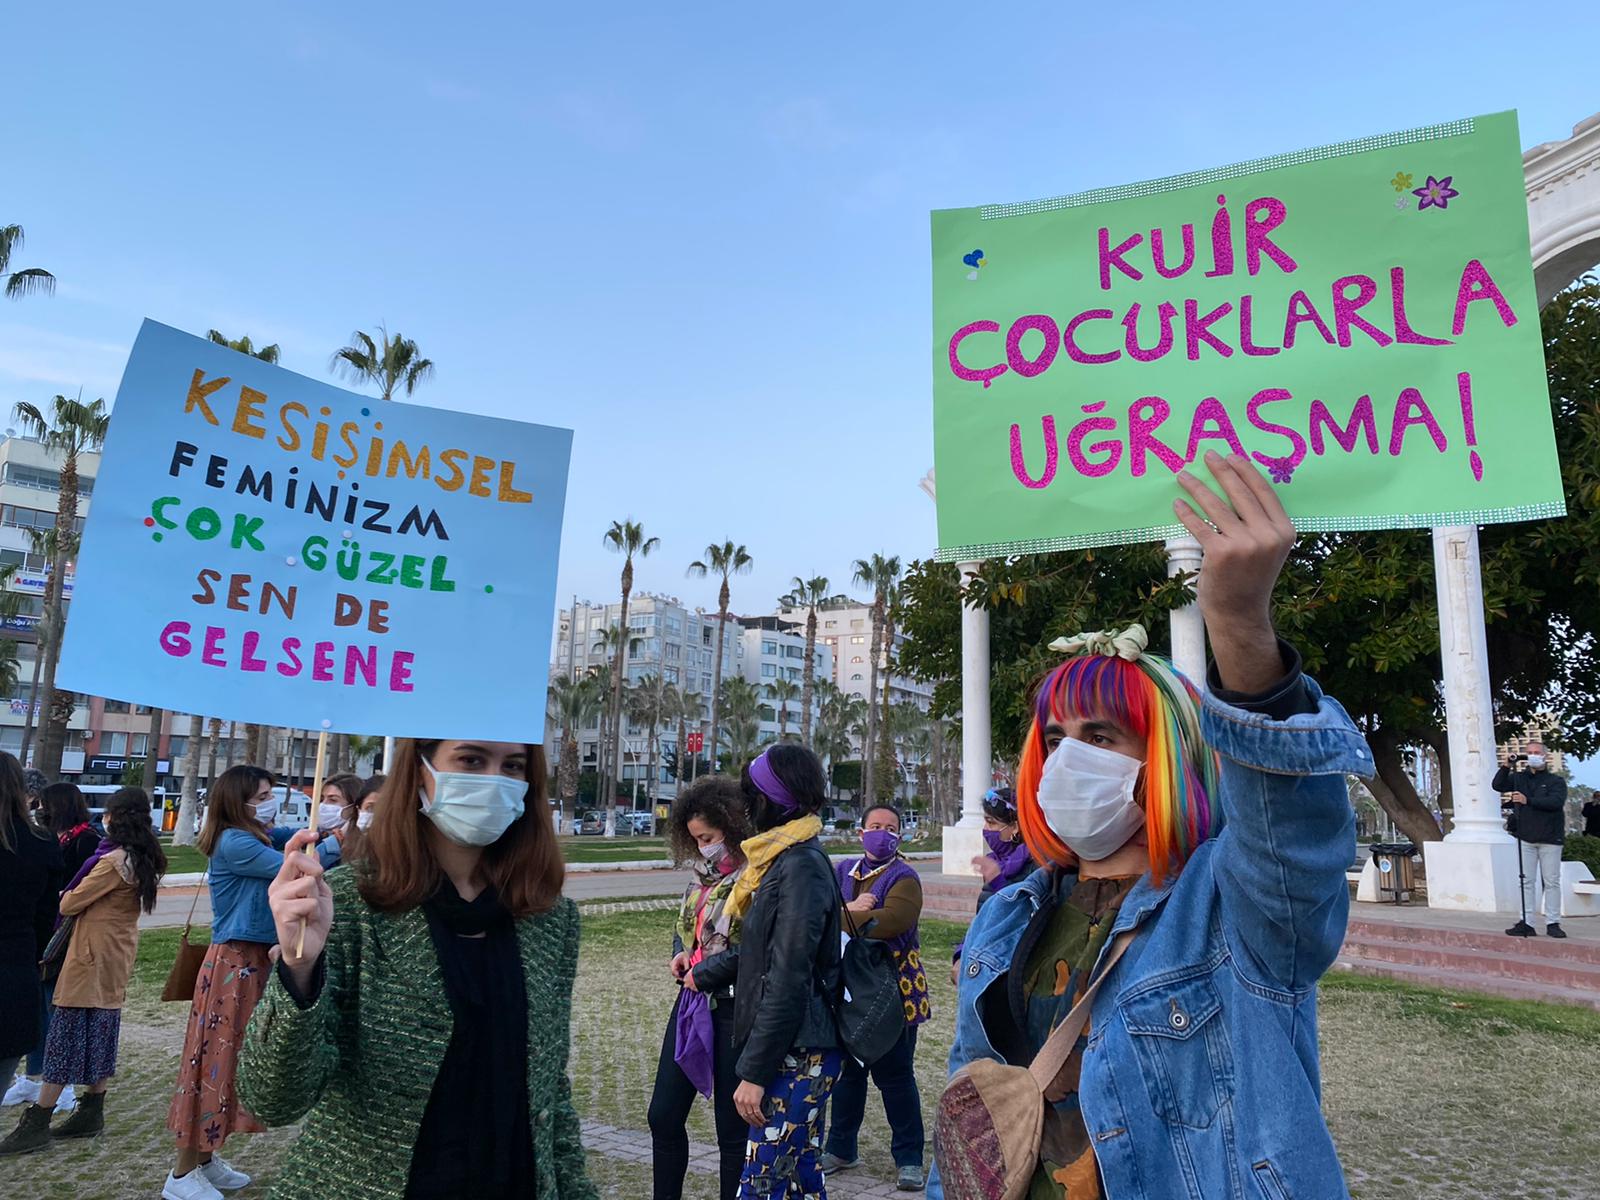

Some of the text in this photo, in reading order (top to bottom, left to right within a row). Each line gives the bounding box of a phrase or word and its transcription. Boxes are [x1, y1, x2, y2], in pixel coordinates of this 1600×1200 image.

[1097, 194, 1298, 290] KUİR
[948, 259, 1518, 389] ÇOCUKLARLA
[151, 496, 266, 552] ÇOK
[168, 440, 450, 541] FEMİNİZM
[191, 568, 391, 634] SEN DE
[159, 620, 415, 693] GELSENE
